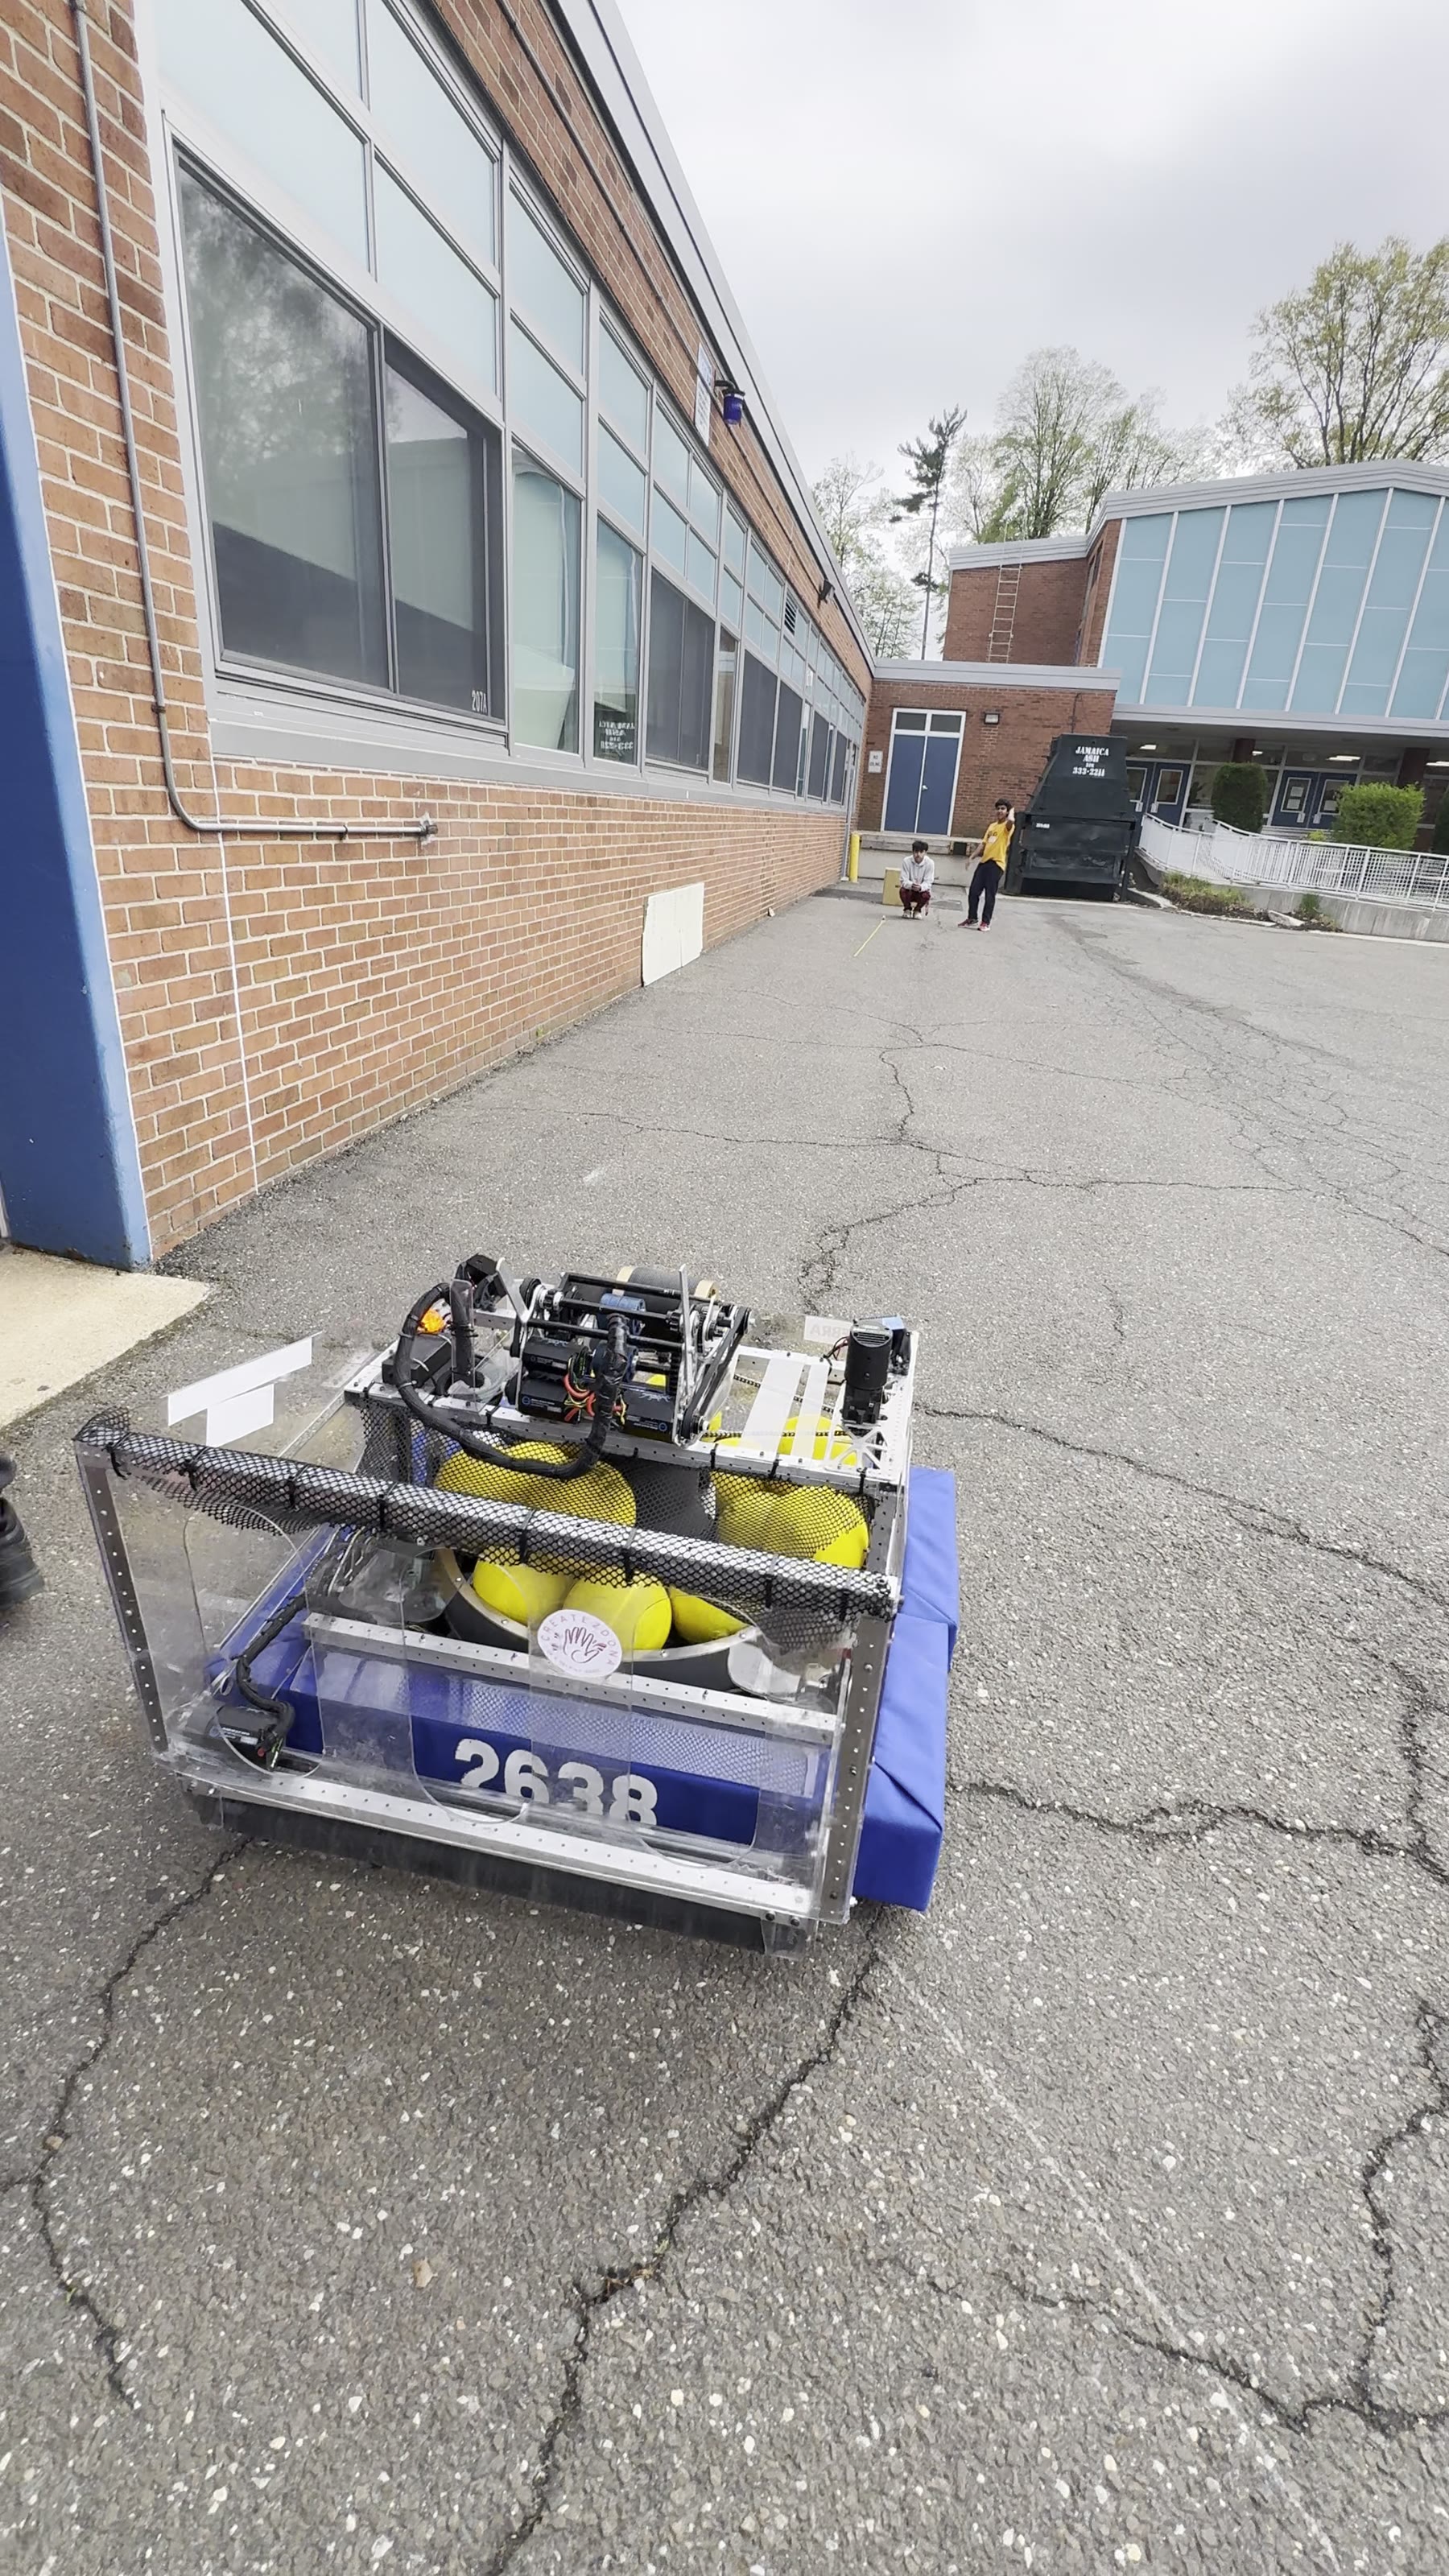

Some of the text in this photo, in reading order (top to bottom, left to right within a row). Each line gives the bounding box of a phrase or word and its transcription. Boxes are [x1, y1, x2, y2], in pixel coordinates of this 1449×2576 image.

[472, 690, 487, 714] 207A
[1075, 746, 1109, 756] JAMAICA
[1083, 754, 1100, 762] ASH
[455, 1738, 658, 1826] 2638
